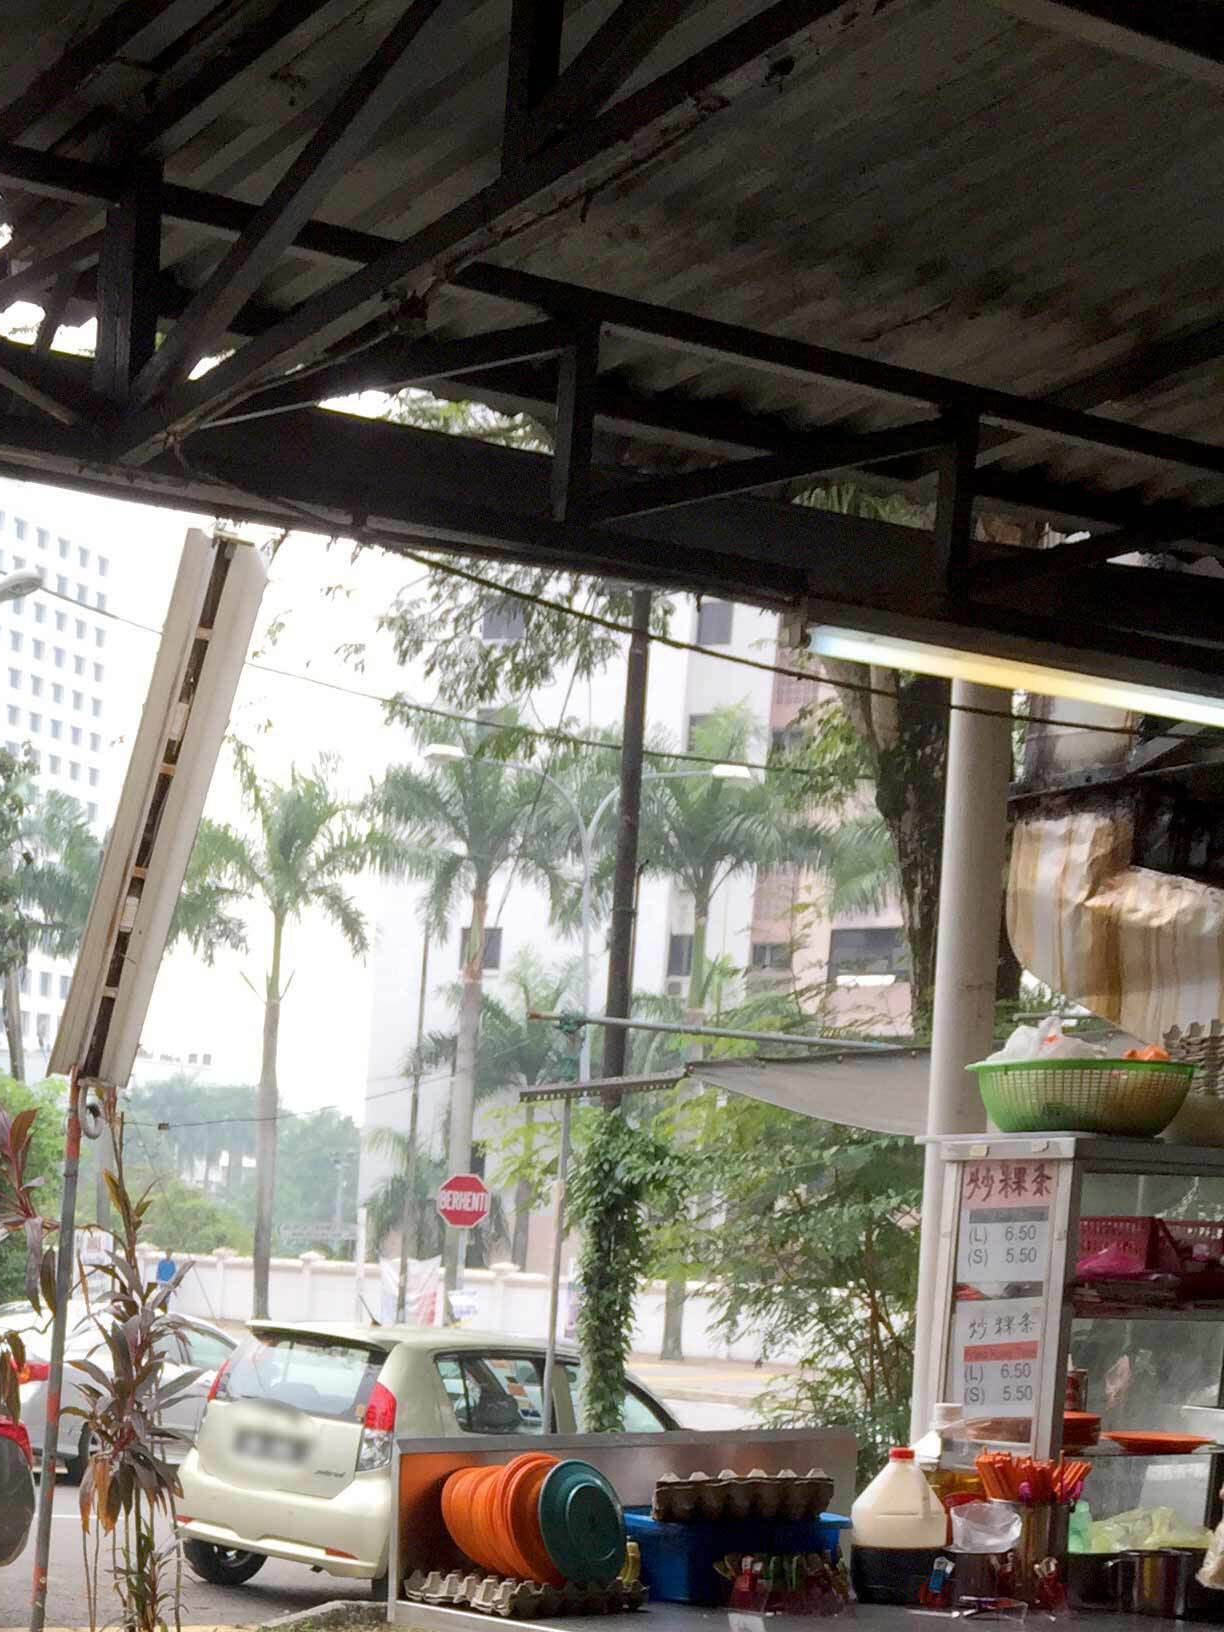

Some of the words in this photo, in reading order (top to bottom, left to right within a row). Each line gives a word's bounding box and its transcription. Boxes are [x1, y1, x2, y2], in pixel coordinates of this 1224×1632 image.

[966, 1163, 1052, 1202] 炒粿条
[440, 1190, 488, 1212] BERHENTI
[969, 1226, 987, 1245] (L)
[1005, 1225, 1037, 1241] 6.50
[968, 1248, 989, 1266] (S)
[1005, 1247, 1037, 1263] 5.50
[964, 1364, 984, 1384] (L)
[1000, 1362, 1031, 1379] 6.50
[964, 1387, 985, 1405] (S)
[1002, 1385, 1032, 1402] 5.50
